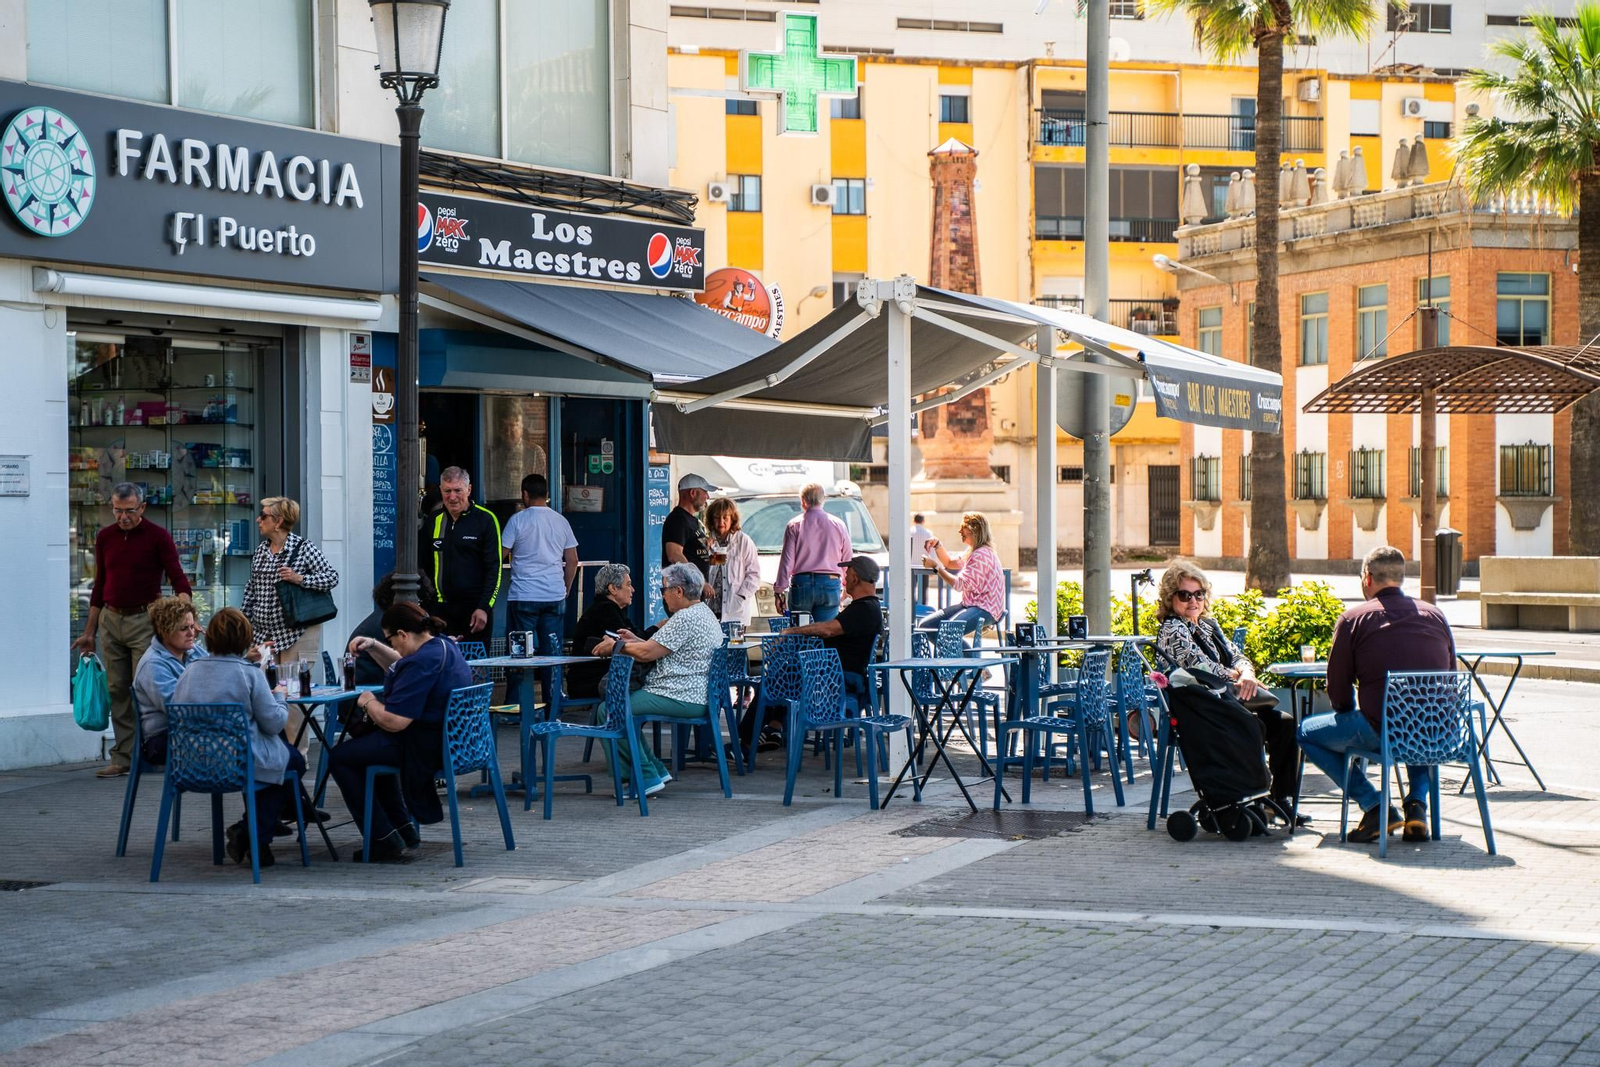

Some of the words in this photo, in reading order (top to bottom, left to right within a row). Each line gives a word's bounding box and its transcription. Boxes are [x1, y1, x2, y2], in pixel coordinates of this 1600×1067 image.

[116, 128, 364, 209] FARMACIA
[437, 206, 457, 217] pepsi
[218, 216, 316, 257] Puerto
[434, 215, 469, 239] MAX
[531, 212, 593, 246] Los
[435, 237, 459, 249] zero
[675, 236, 692, 246] pepsi
[478, 237, 641, 282] Maestres
[673, 245, 701, 267] MAX
[674, 263, 693, 275] zero
[1187, 381, 1200, 413] BAR
[1203, 384, 1215, 416] LOS
[1218, 387, 1251, 420] MAESTRES
